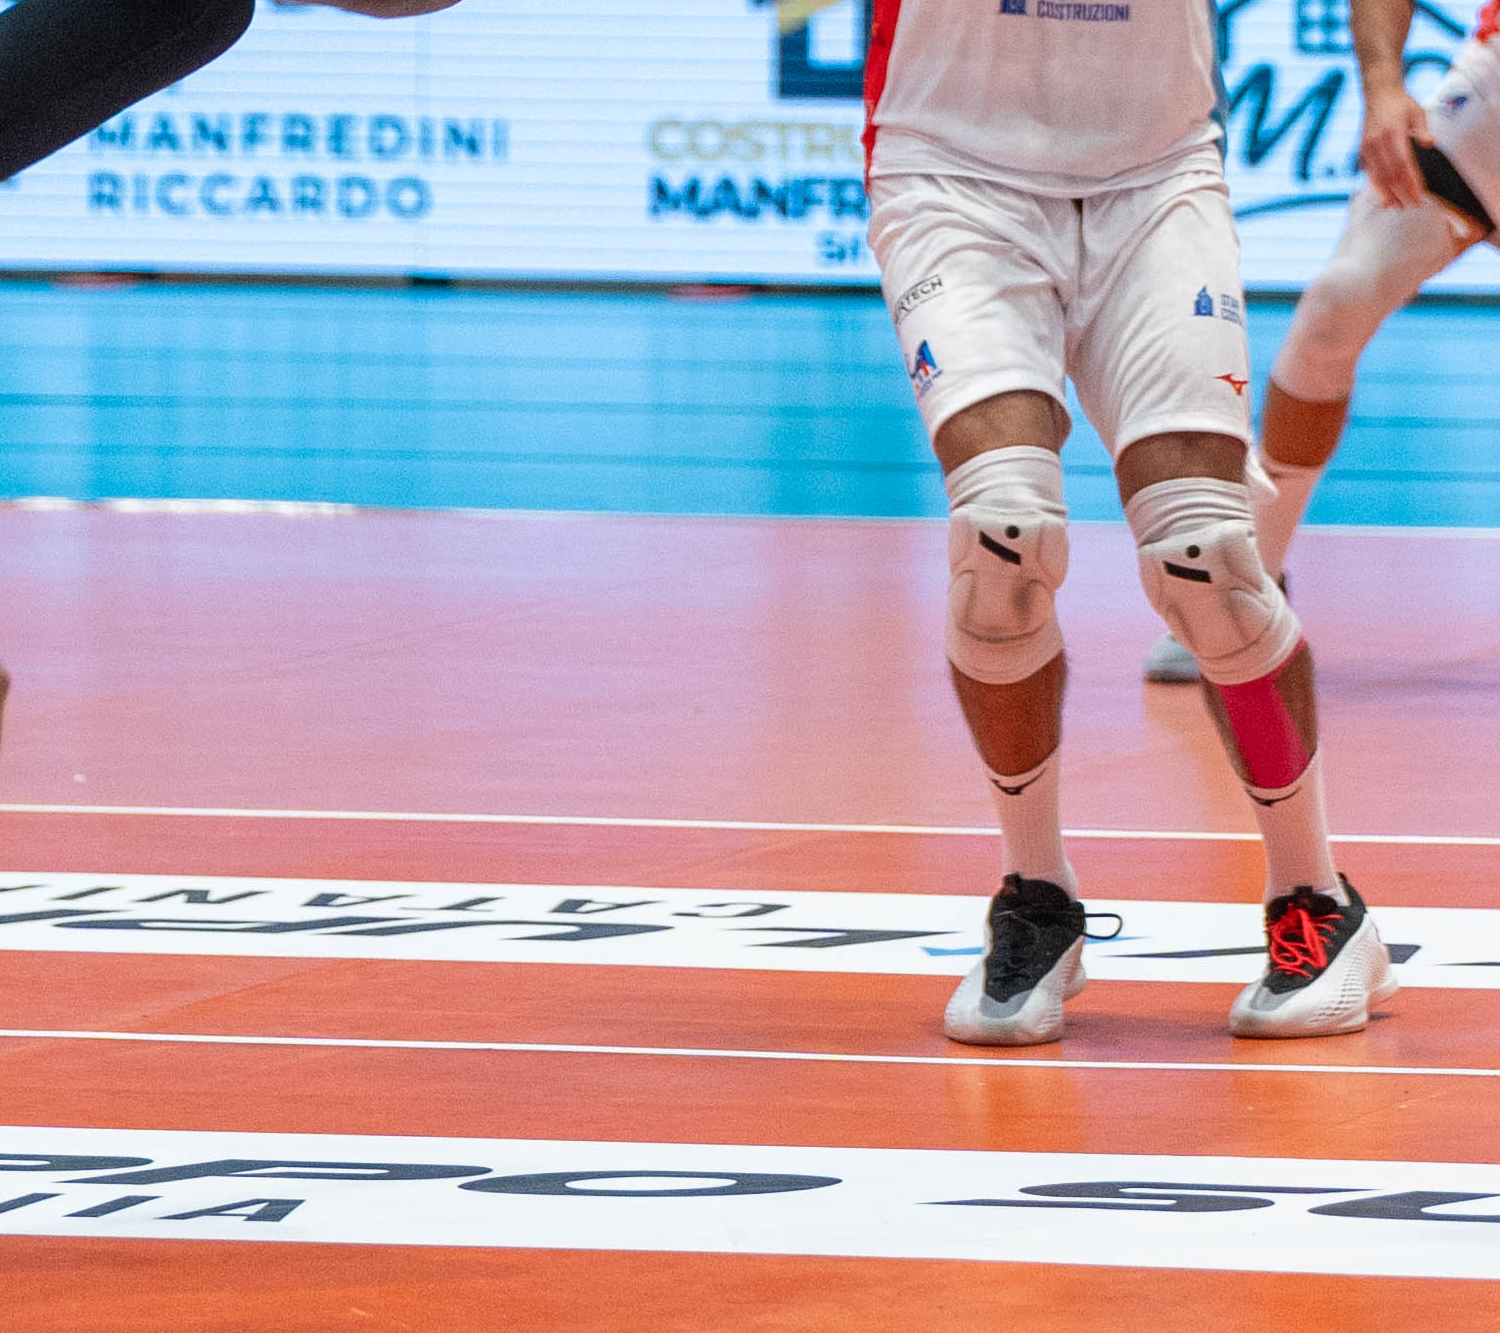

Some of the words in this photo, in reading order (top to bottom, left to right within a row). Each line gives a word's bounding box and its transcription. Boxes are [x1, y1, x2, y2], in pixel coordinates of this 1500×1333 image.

[1036, 0, 1131, 22] COSTRUZIONI
[88, 112, 507, 161] MANFREDINI
[87, 171, 434, 220] RICCARDO
